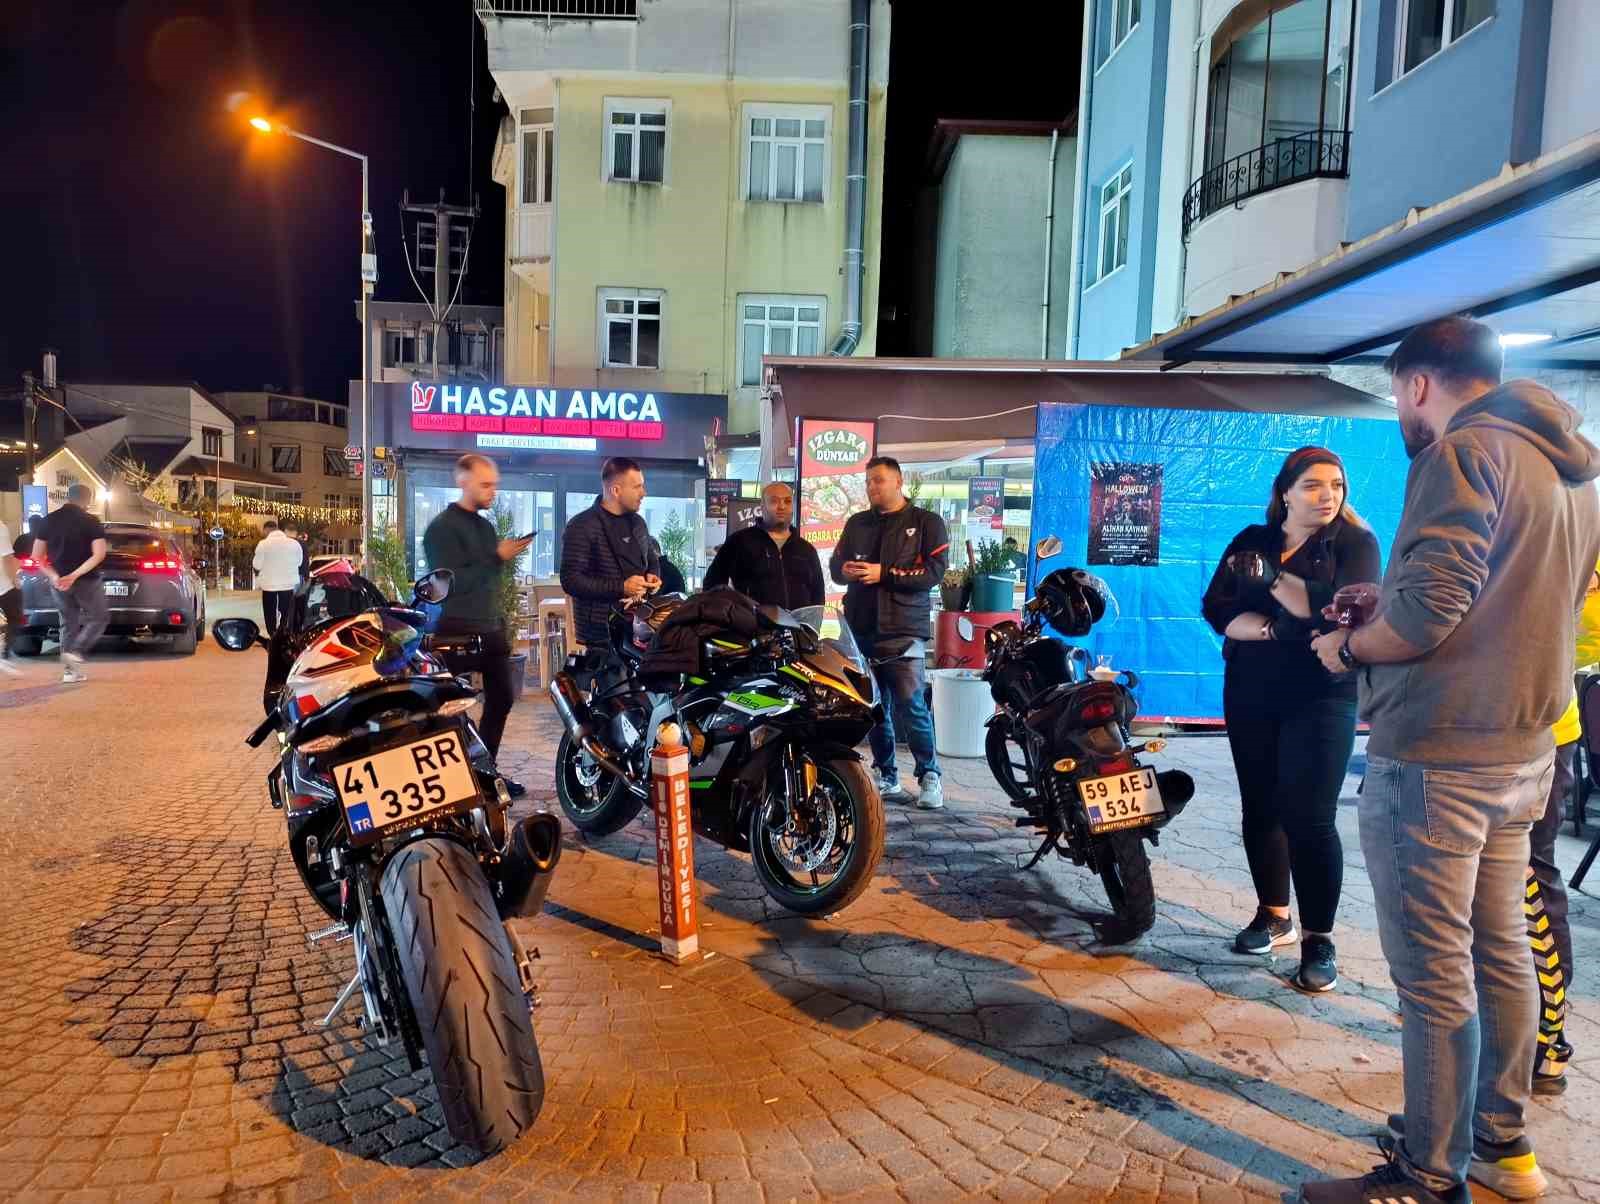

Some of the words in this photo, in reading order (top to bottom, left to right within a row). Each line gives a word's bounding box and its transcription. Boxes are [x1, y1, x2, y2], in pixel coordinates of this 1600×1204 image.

[441, 385, 557, 416] HASAN
[565, 391, 661, 422] AMCA
[1105, 484, 1148, 496] HALLOWEEN
[344, 761, 379, 794] 41
[411, 738, 460, 774] RR
[380, 775, 446, 819] 335
[1085, 782, 1108, 800] 59
[1119, 772, 1153, 794] AEJ
[1106, 797, 1141, 818] 534
[353, 818, 372, 832] TR
